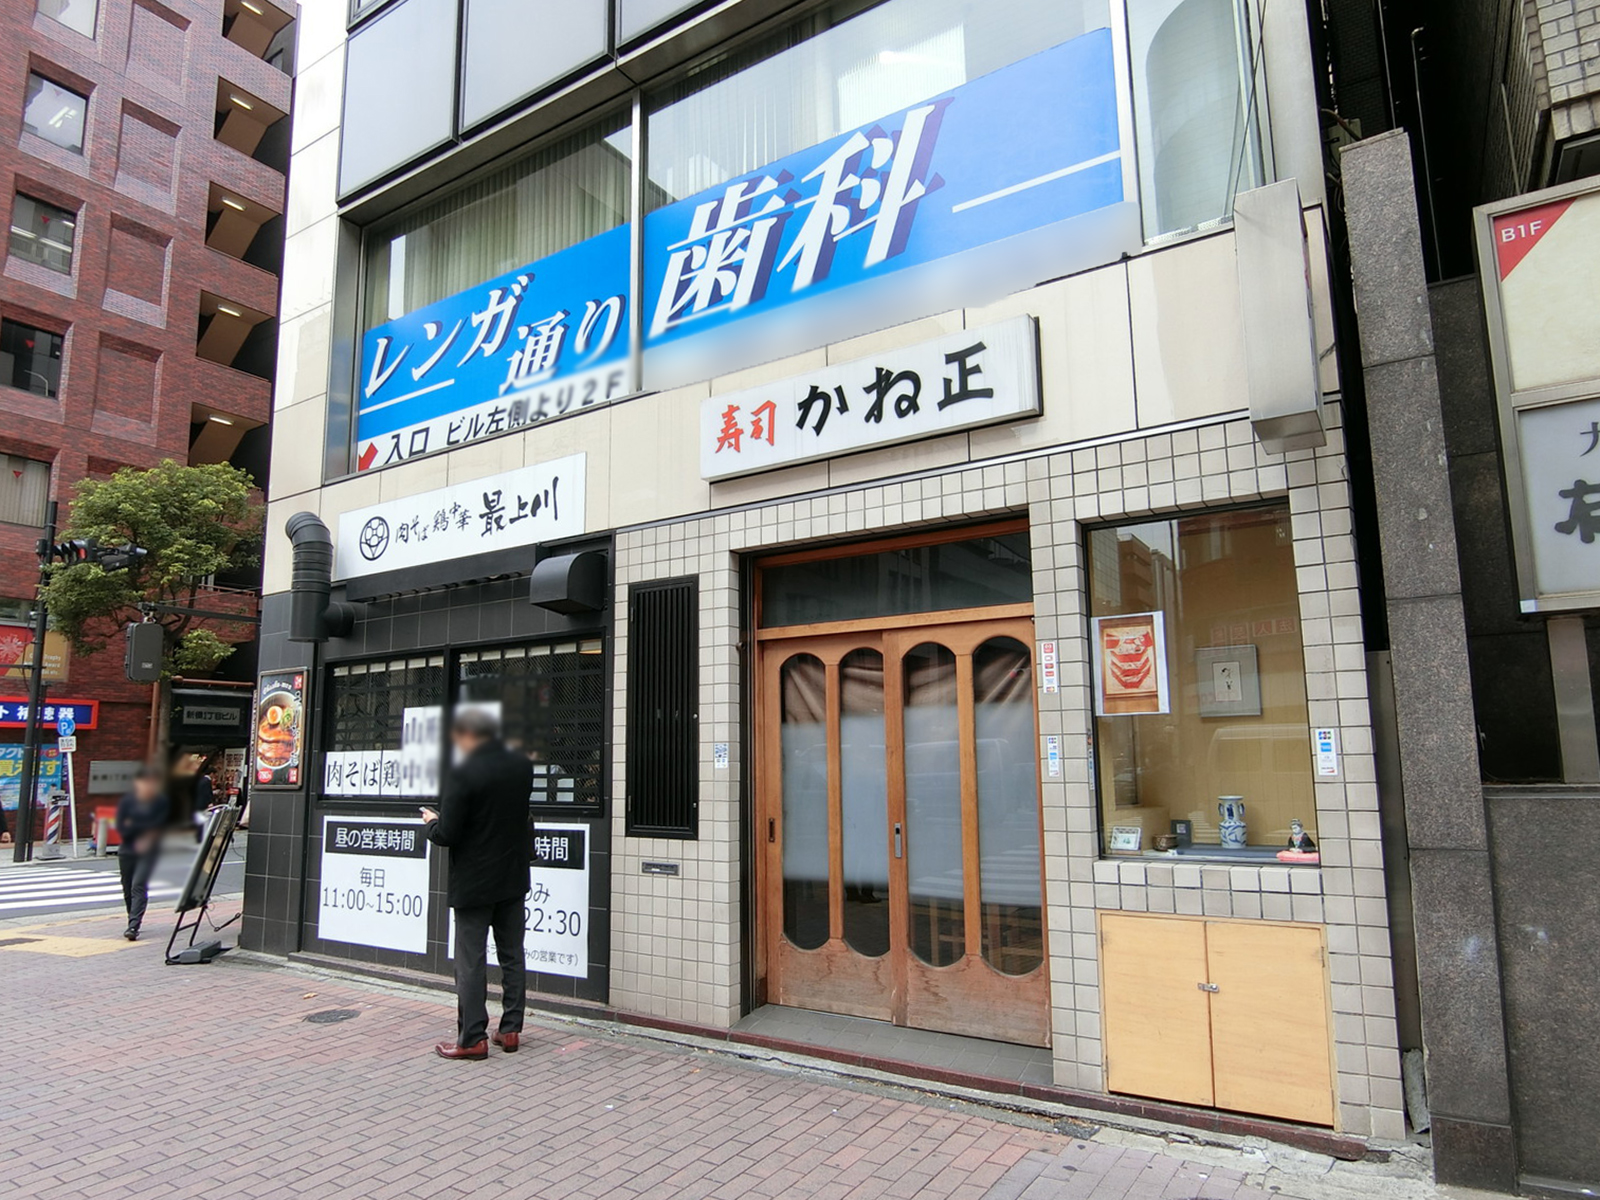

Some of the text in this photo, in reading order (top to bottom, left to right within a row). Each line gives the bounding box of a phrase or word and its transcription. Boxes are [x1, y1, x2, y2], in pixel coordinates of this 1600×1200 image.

[365, 98, 952, 399] レンガ通り 歯科
[1501, 220, 1542, 243] B1F
[715, 341, 994, 453] 寿司 かね正
[384, 427, 430, 465] 入口
[479, 476, 559, 537] 最上川
[335, 828, 415, 851] 昼の営業時間
[360, 867, 386, 888] 毎日
